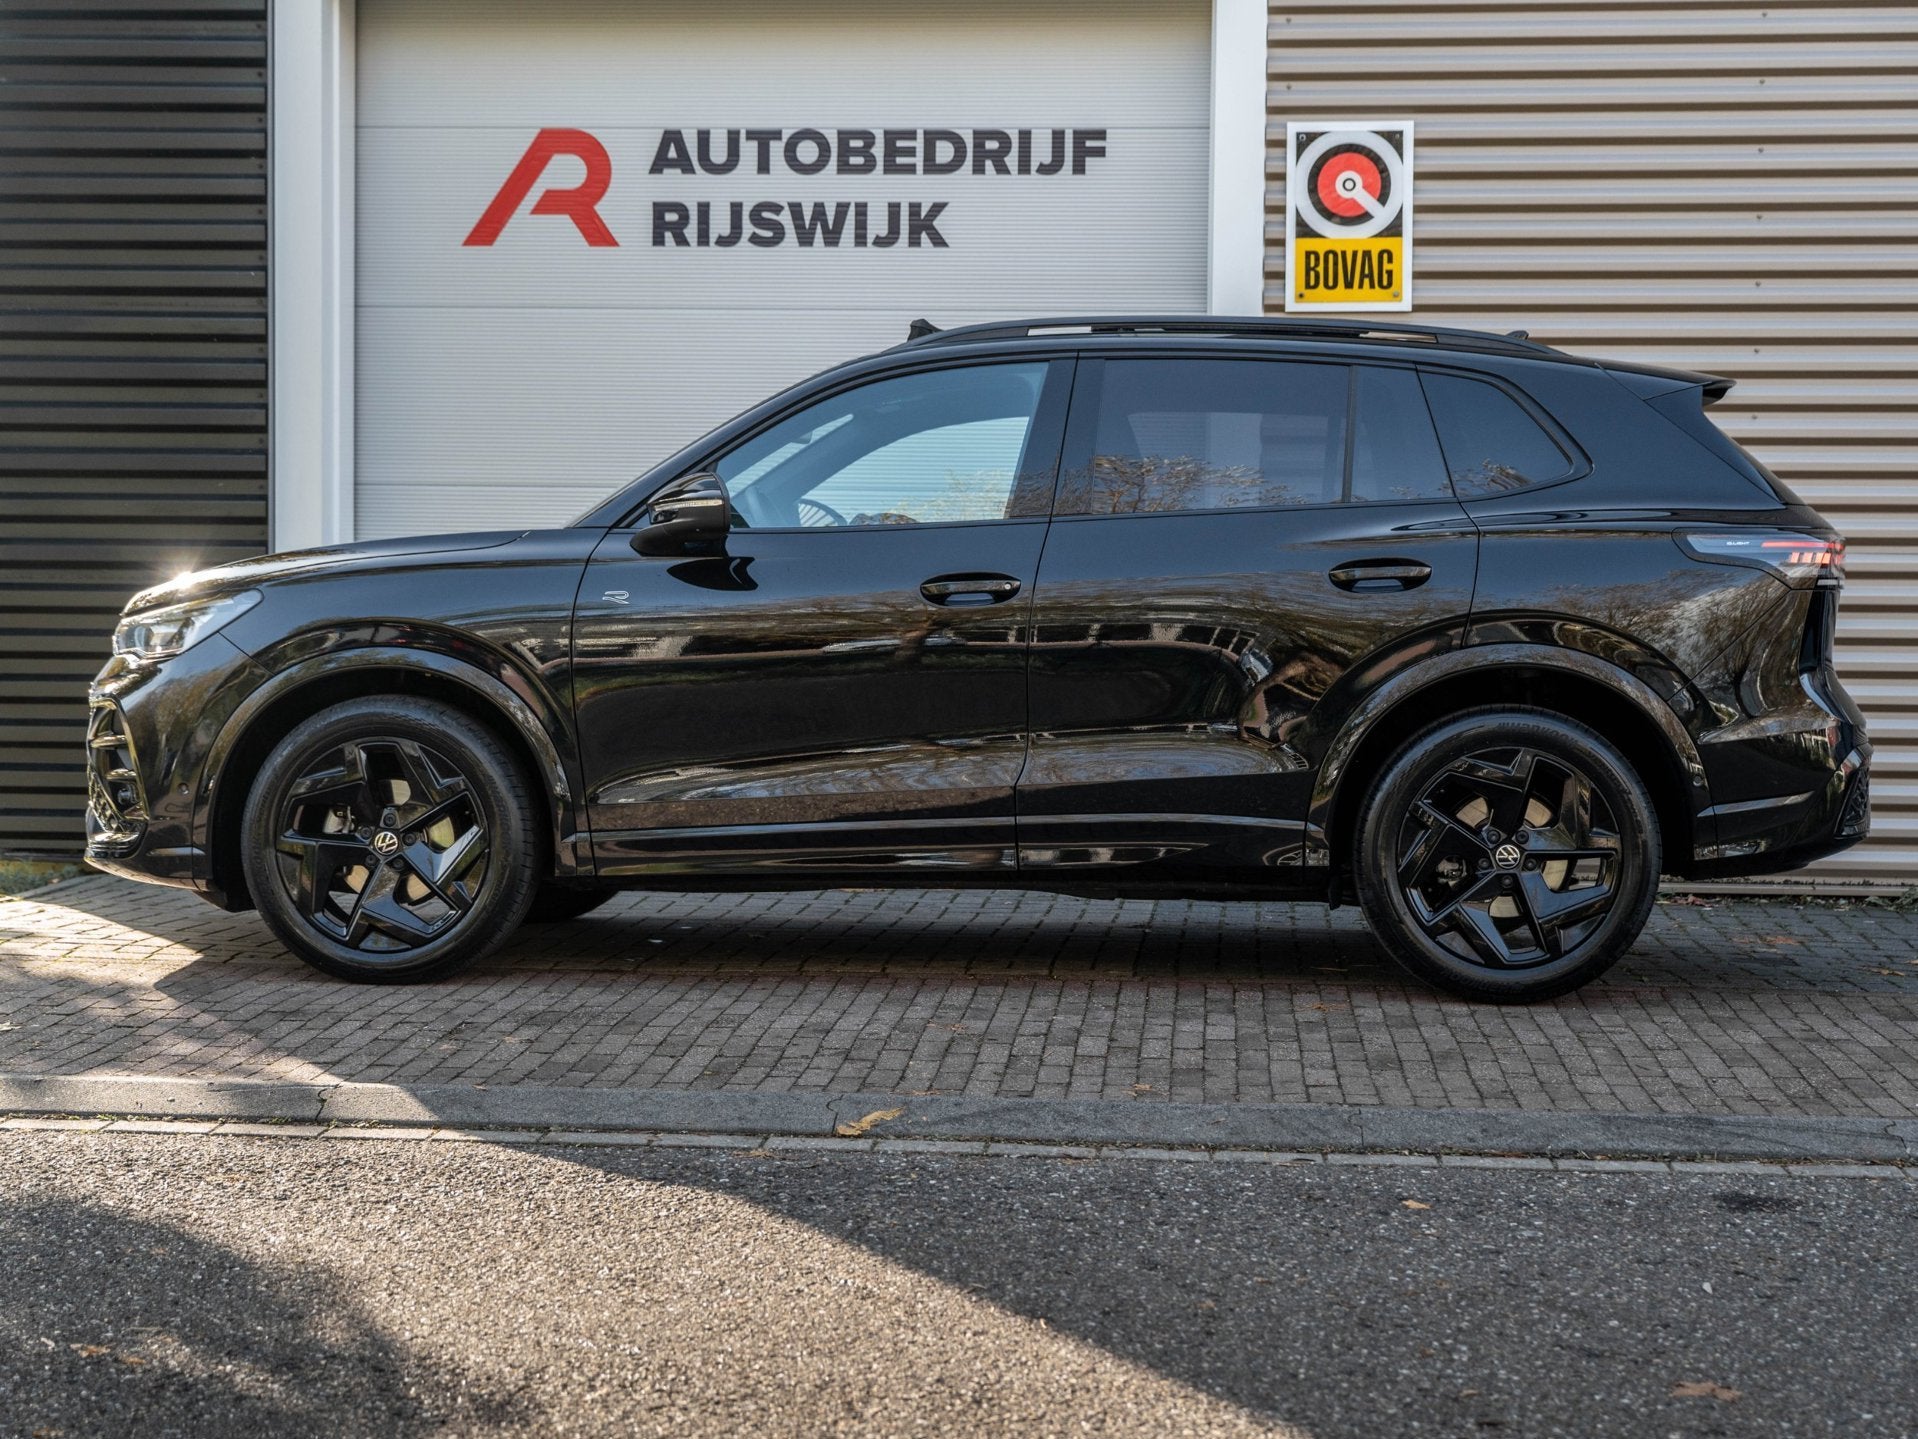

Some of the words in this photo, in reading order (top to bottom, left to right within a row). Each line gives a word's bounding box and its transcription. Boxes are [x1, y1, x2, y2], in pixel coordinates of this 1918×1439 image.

[648, 129, 1107, 175] AUTOBEDRIJF
[651, 201, 950, 248] RIJSWIJK
[1305, 248, 1394, 291] BOVAG
